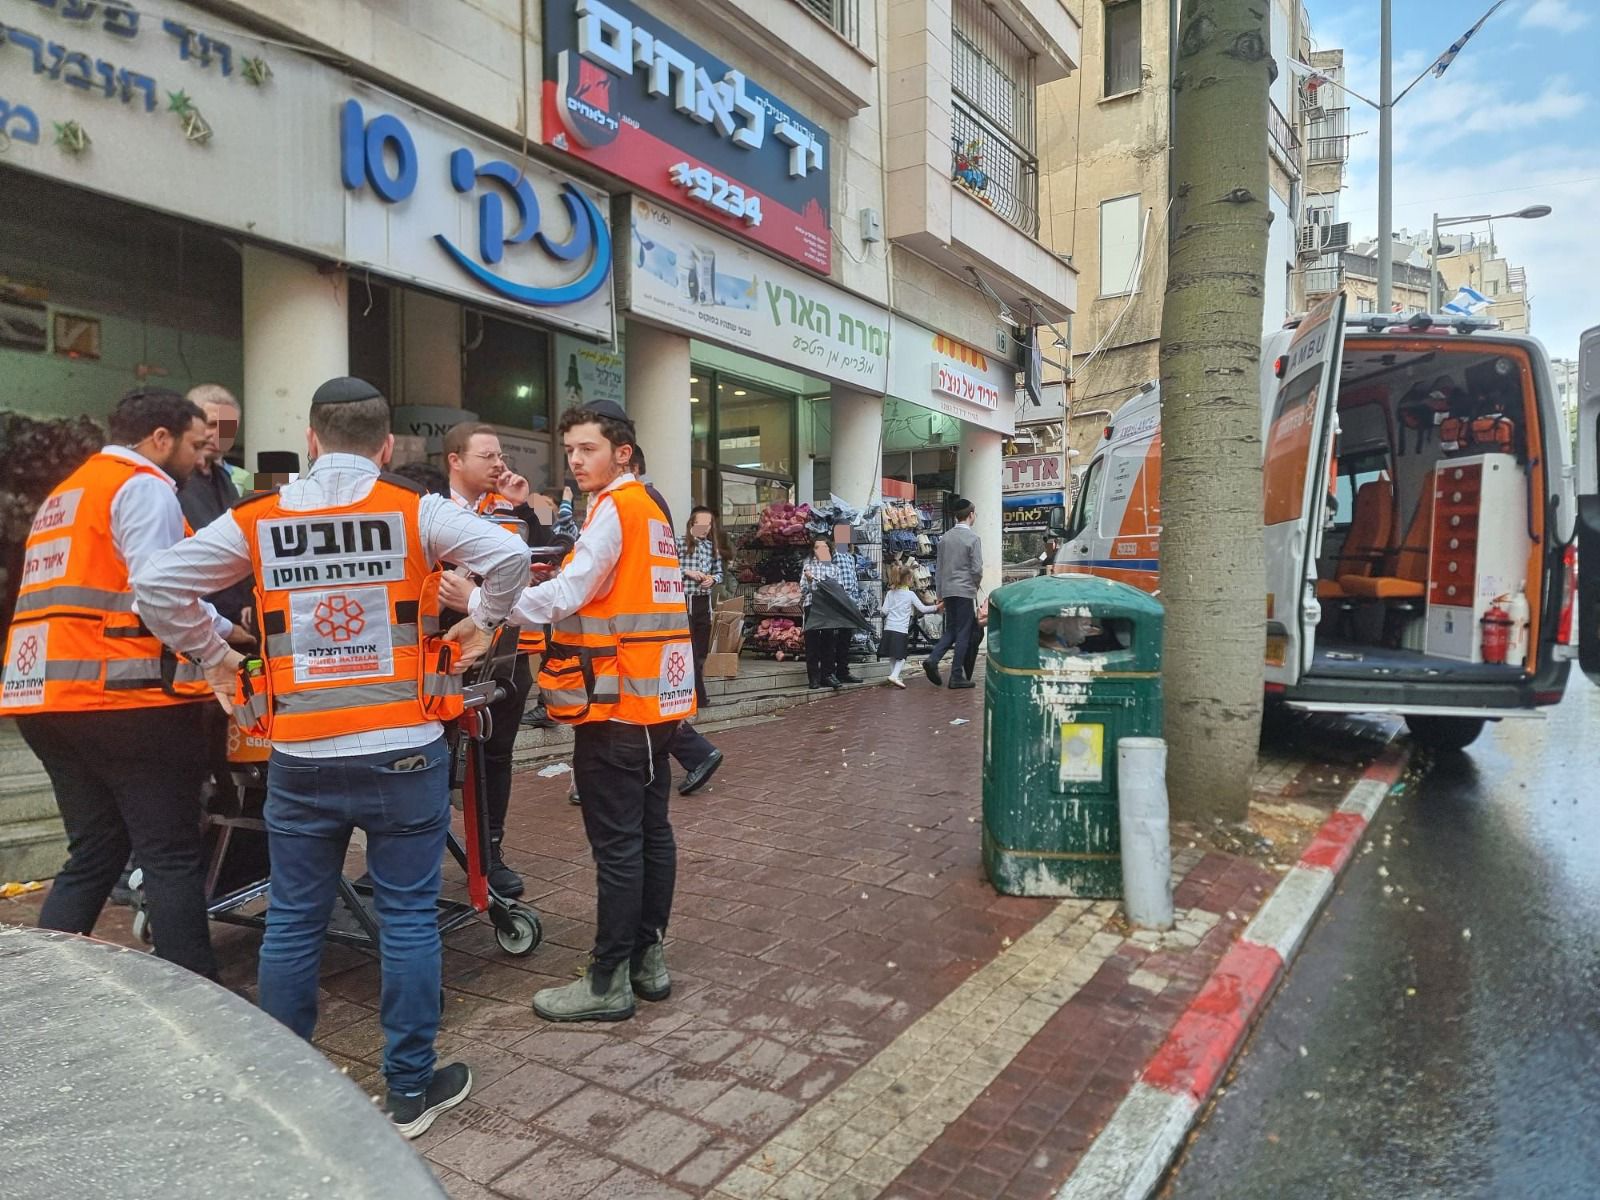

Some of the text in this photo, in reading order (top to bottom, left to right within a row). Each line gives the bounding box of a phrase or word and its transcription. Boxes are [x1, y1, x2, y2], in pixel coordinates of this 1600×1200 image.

[577, 0, 823, 178] יד לאחים
[567, 96, 606, 125] לאחים
[605, 117, 619, 130] יד
[764, 280, 831, 337] הארץ
[792, 335, 875, 375] מוצרים מן הטבע
[997, 333, 1005, 350] 16
[1290, 335, 1326, 369] AMBU
[408, 421, 452, 438] ארץ
[270, 519, 392, 558] חובש
[272, 560, 392, 588] יחידת חוסן
[308, 644, 377, 657] איחוד הצלה
